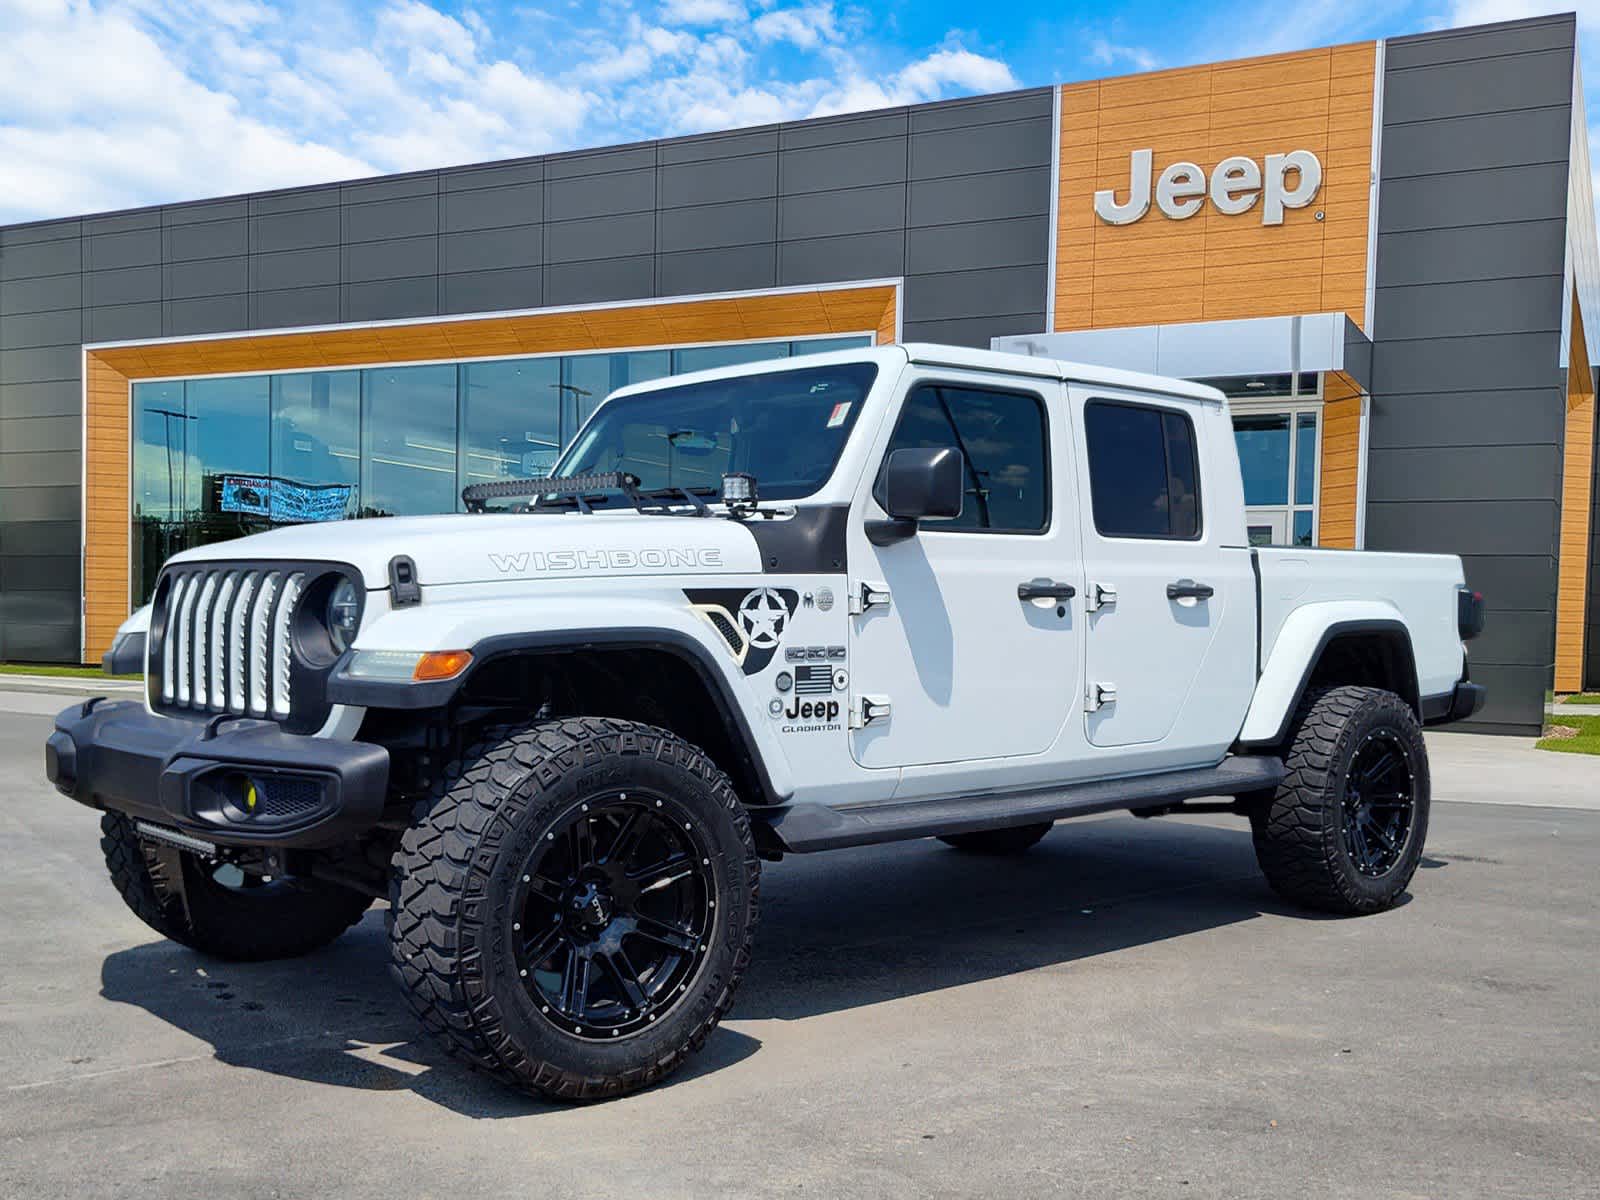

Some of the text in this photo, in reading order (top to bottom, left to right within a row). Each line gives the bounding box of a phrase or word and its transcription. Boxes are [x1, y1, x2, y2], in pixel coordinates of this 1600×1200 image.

[1094, 148, 1322, 226] Jeep
[488, 548, 723, 572] WISHBONE
[785, 697, 839, 721] Jeep
[782, 724, 841, 733] GLADIATOR
